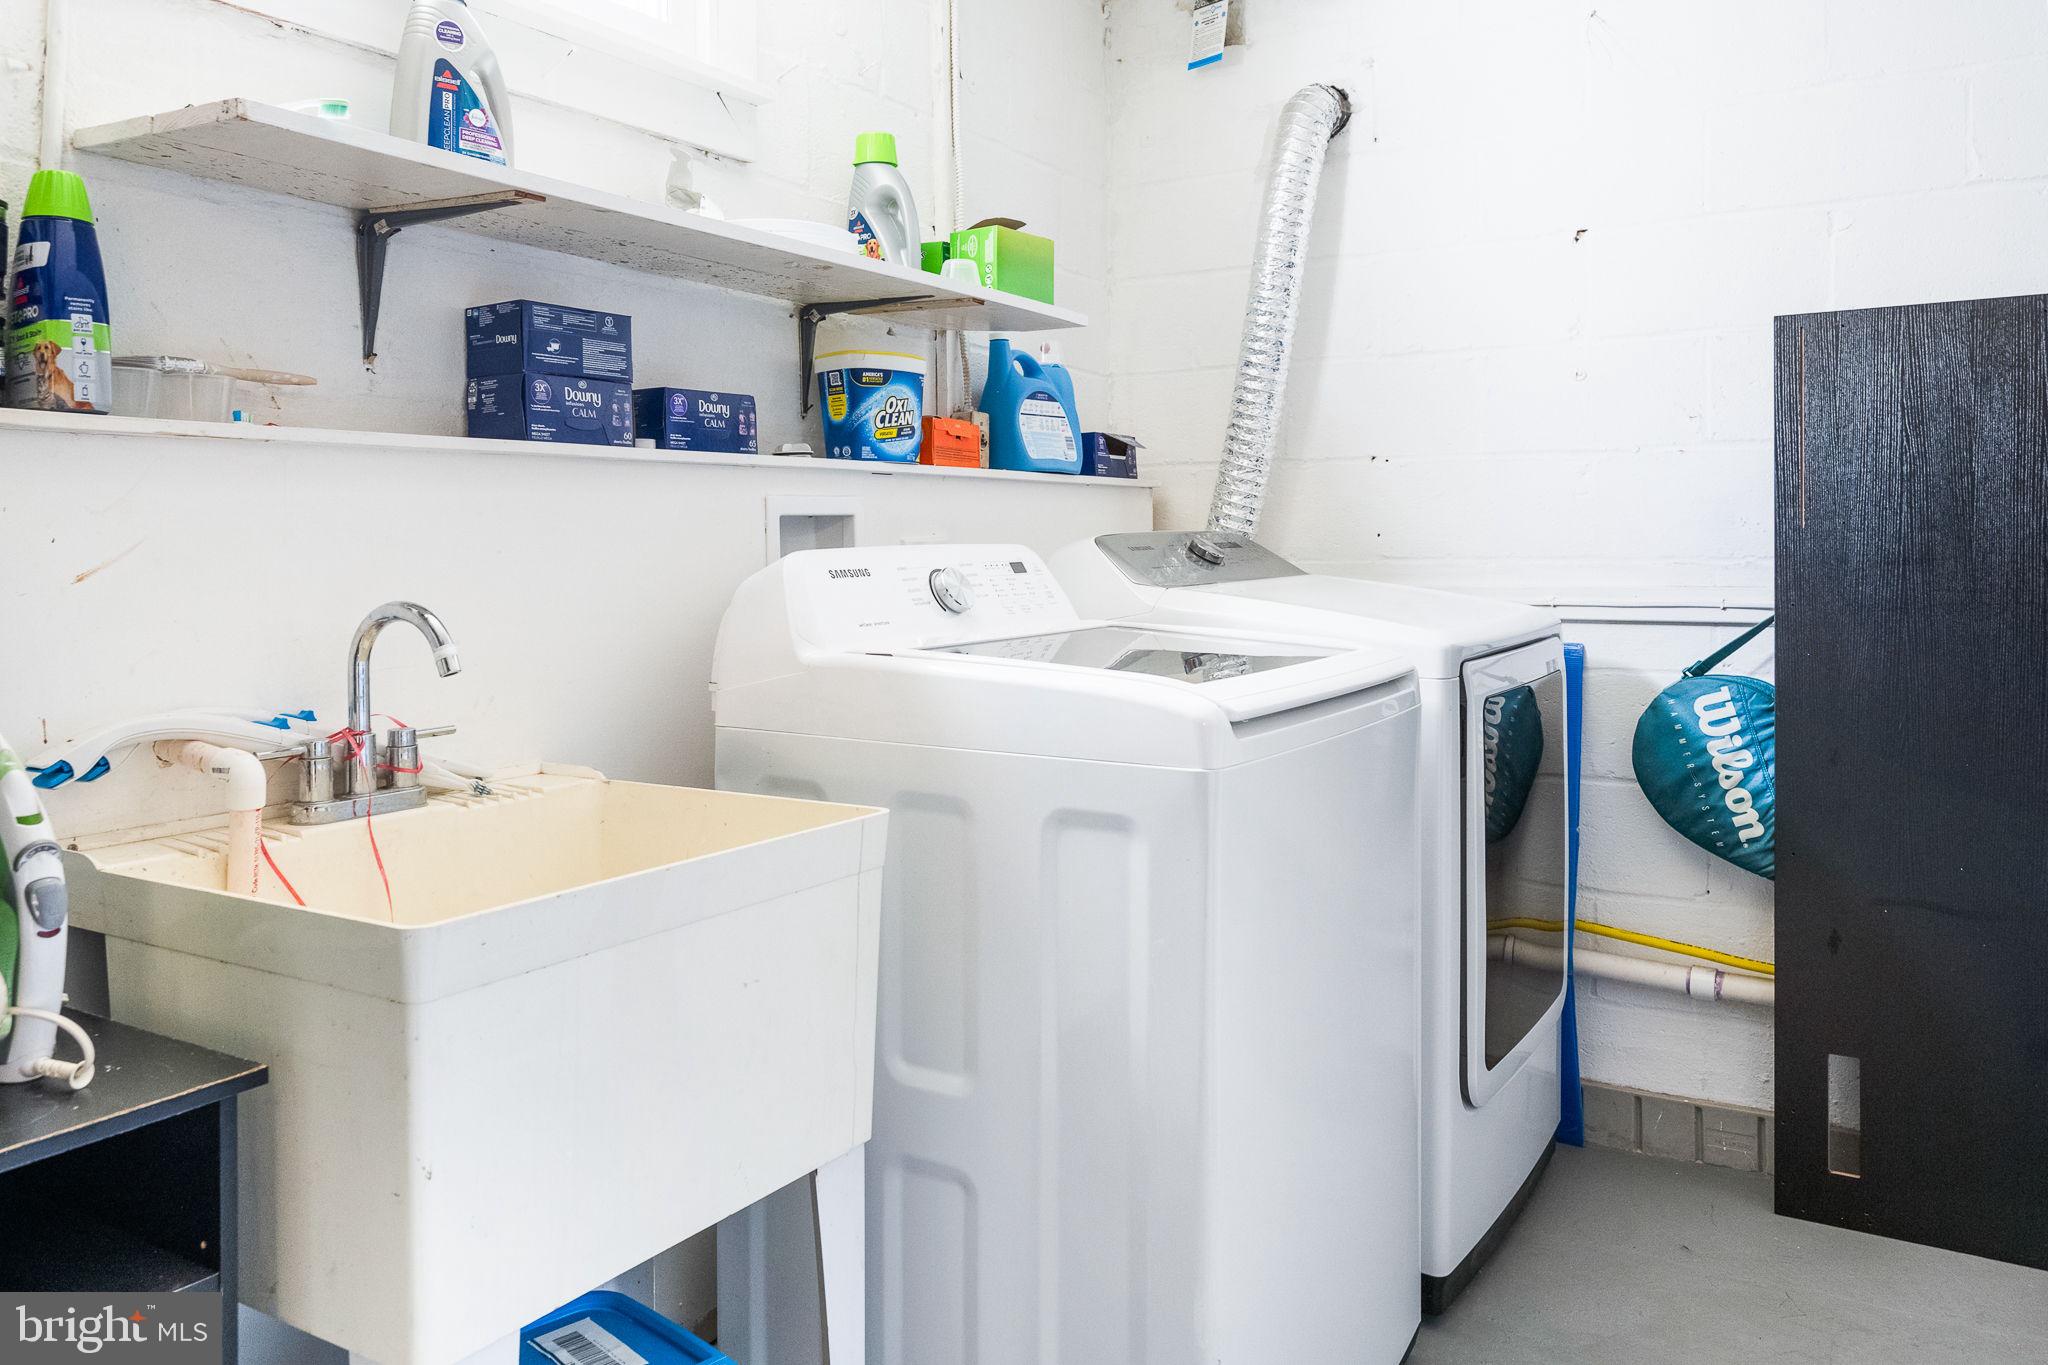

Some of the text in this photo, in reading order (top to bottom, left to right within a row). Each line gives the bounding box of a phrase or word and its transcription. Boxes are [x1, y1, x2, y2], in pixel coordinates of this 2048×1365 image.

[443, 110, 451, 151] EEPCLEAN
[495, 334, 517, 344] Downy
[564, 386, 602, 407] Downy
[885, 396, 908, 413] OXI
[572, 407, 597, 418] CALM
[698, 399, 730, 418] Downy
[704, 418, 726, 428] CALM
[875, 410, 914, 428] CLEAN
[623, 432, 633, 440] 60
[828, 568, 871, 579] SAMSUNG
[1693, 685, 1765, 843] Wilson
[1667, 699, 1725, 847] HAMMER SYSTEM
